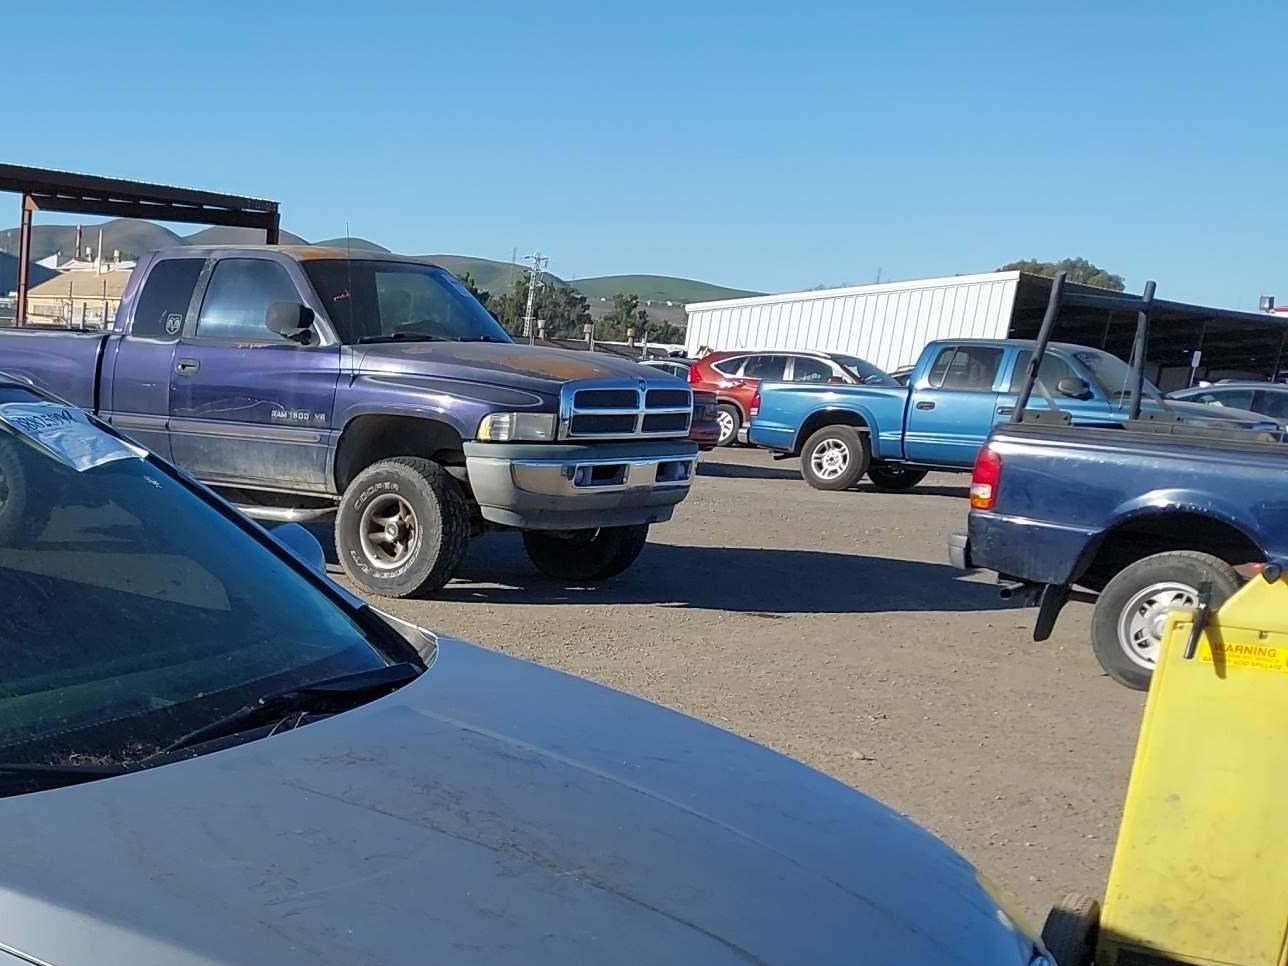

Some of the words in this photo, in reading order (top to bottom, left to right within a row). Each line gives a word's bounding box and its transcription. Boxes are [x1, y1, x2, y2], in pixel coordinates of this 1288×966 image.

[271, 410, 287, 418] RAM
[353, 481, 400, 511] COOPER
[1214, 642, 1278, 658] WARNING
